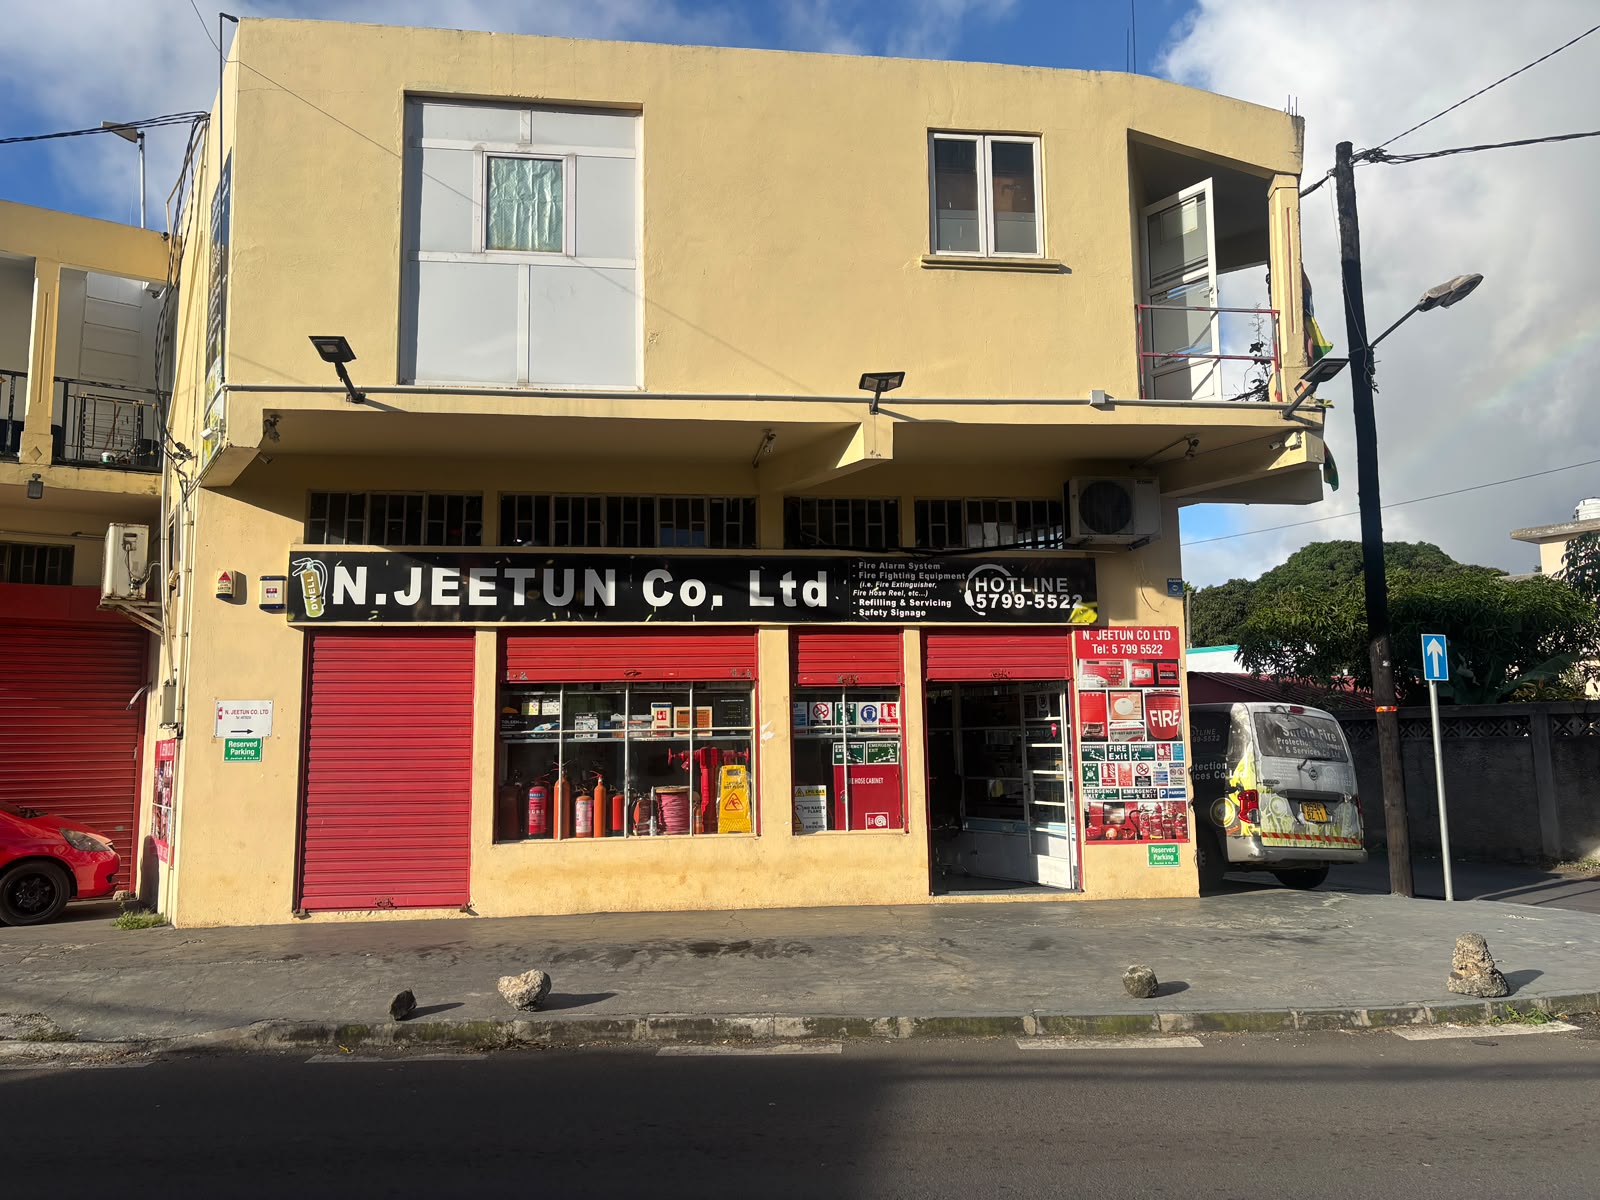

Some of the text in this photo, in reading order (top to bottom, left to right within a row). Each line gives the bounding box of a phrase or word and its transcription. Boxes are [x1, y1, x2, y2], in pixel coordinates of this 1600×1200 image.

[858, 561, 941, 571] Fire Alarm System
[858, 571, 966, 581] Fire Fighting Equipment
[642, 568, 723, 607] Co.
[749, 569, 828, 608] Ltd
[891, 581, 937, 589] Extinguisher,
[975, 577, 1069, 593] HOTLINE
[307, 575, 319, 611] DWELL
[888, 589, 906, 597] Reel,
[859, 598, 897, 608] Refilling
[909, 599, 952, 608] Servicing
[975, 593, 1083, 609] 5799-5522
[858, 608, 927, 618] Safety Signage
[1082, 630, 1171, 640] N. JEETUN CO LTD
[1091, 644, 1163, 655] Tel: 5 799 5522
[1149, 709, 1180, 727] FIRE
[1317, 728, 1337, 742] Fire
[228, 740, 258, 748] Reserved
[230, 748, 255, 756] Parking
[1108, 752, 1128, 760] Exit
[1292, 746, 1321, 756] Services
[1213, 770, 1226, 779] Co
[1160, 790, 1167, 798] P
